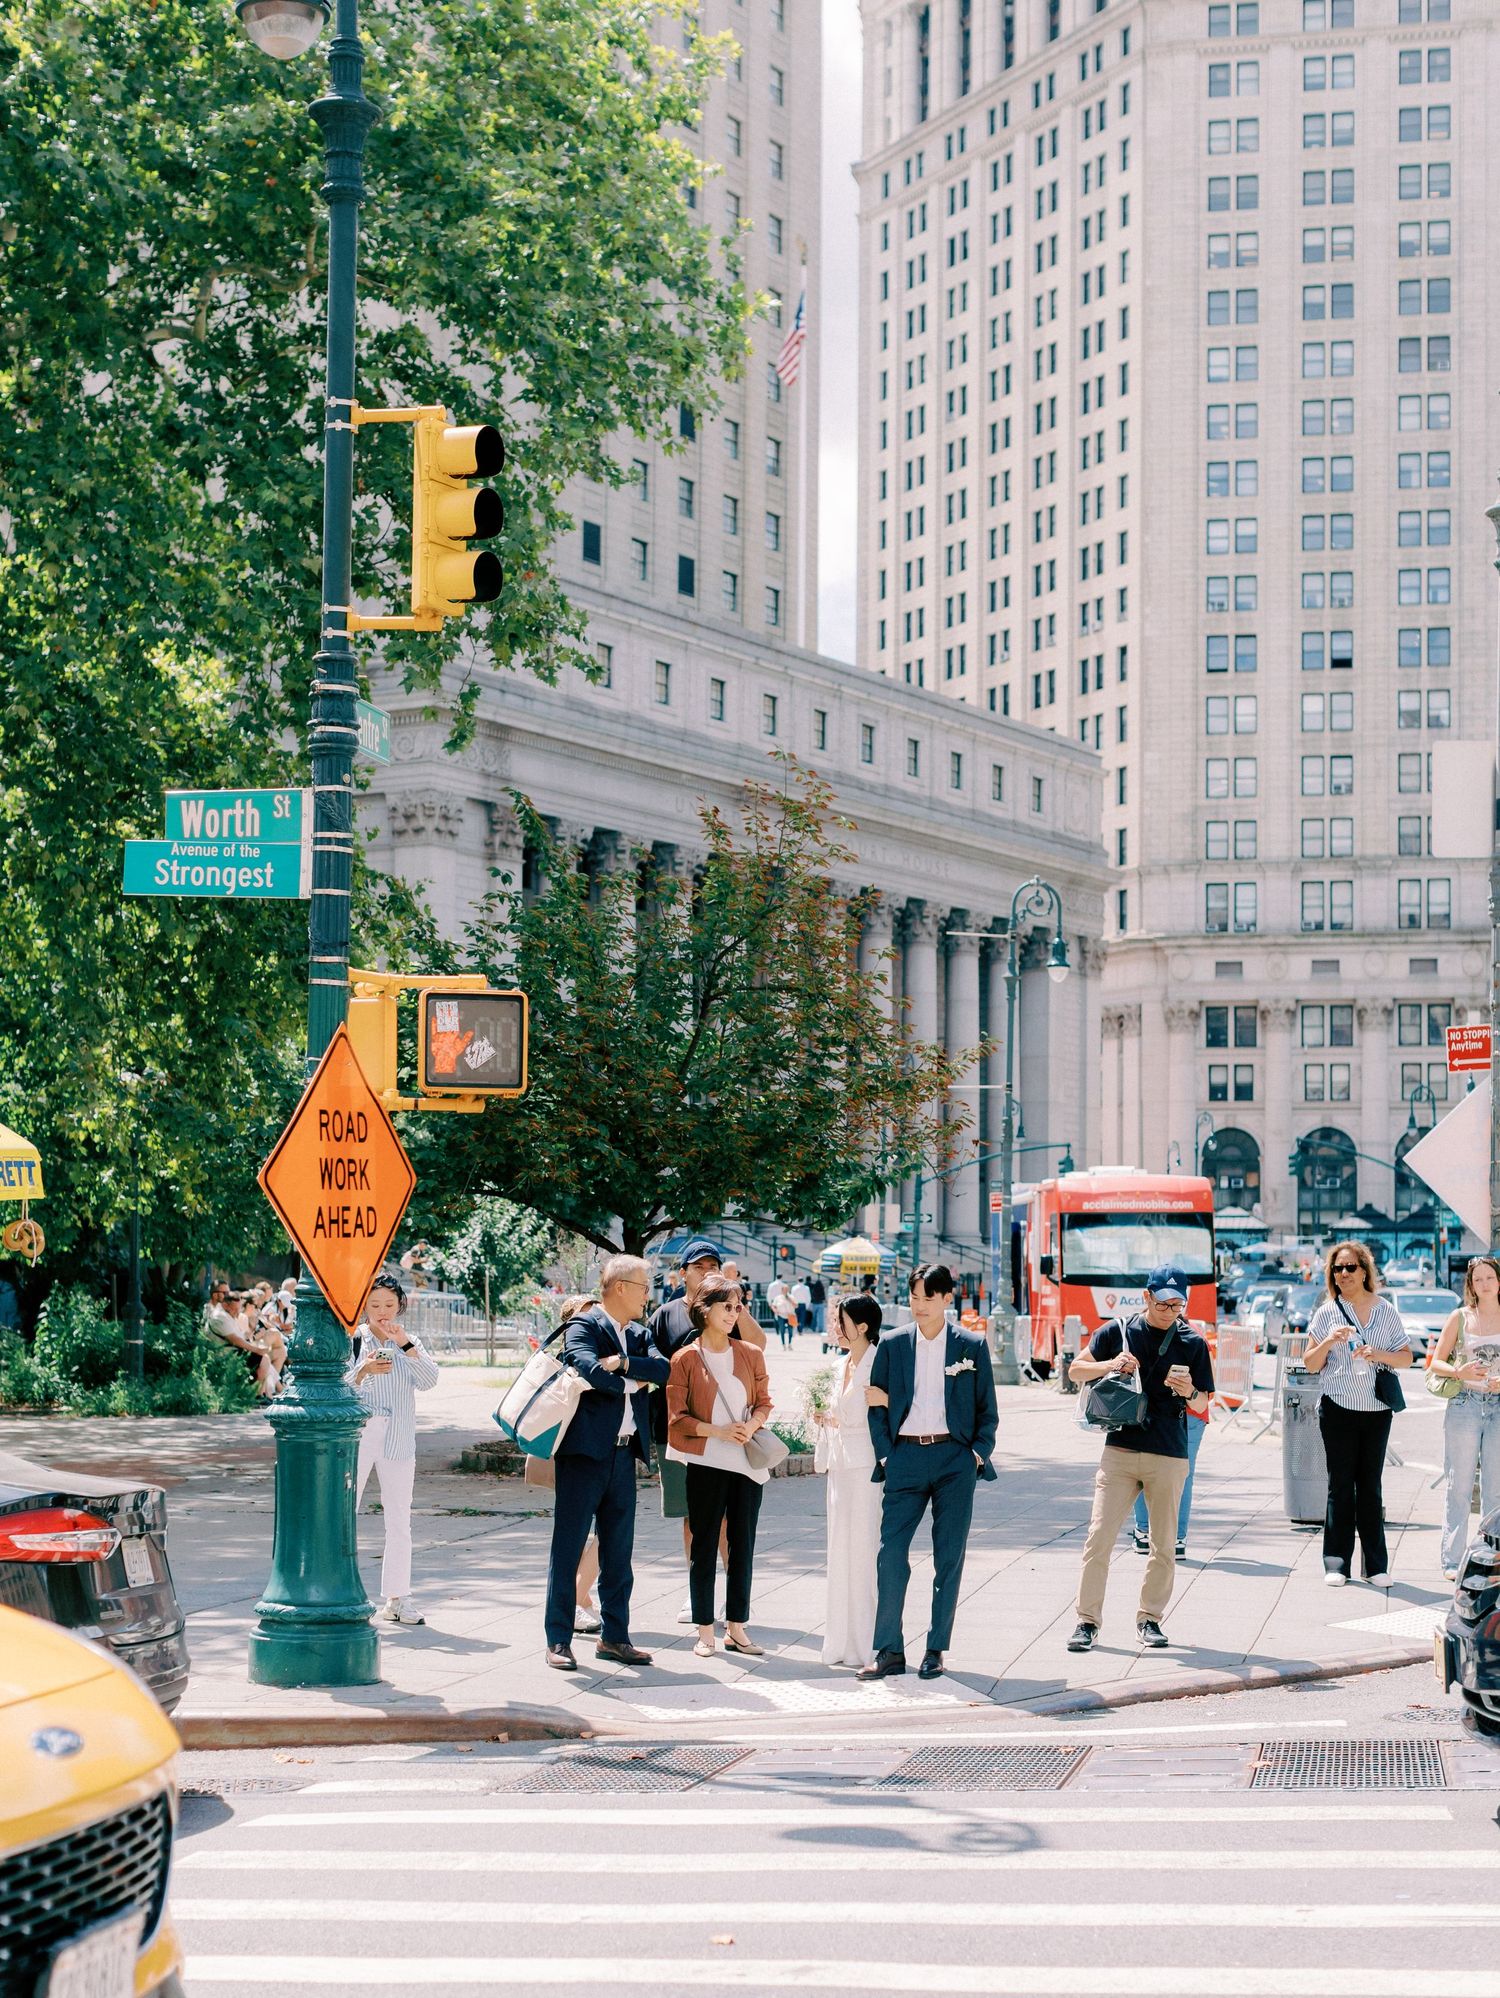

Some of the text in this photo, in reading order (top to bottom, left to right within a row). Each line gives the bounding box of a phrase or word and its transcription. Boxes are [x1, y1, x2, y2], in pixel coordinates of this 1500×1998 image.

[180, 794, 291, 839] Worth St
[171, 843, 261, 858] Avenue of the
[154, 858, 274, 896] Strongest
[1450, 1031, 1461, 1040] NO
[1451, 1041, 1483, 1052] Anytime
[319, 1109, 368, 1143] ROAD
[319, 1157, 371, 1191] WORK
[1082, 1200, 1194, 1210] acclaimedmobile.com
[313, 1206, 377, 1239] AHEAD
